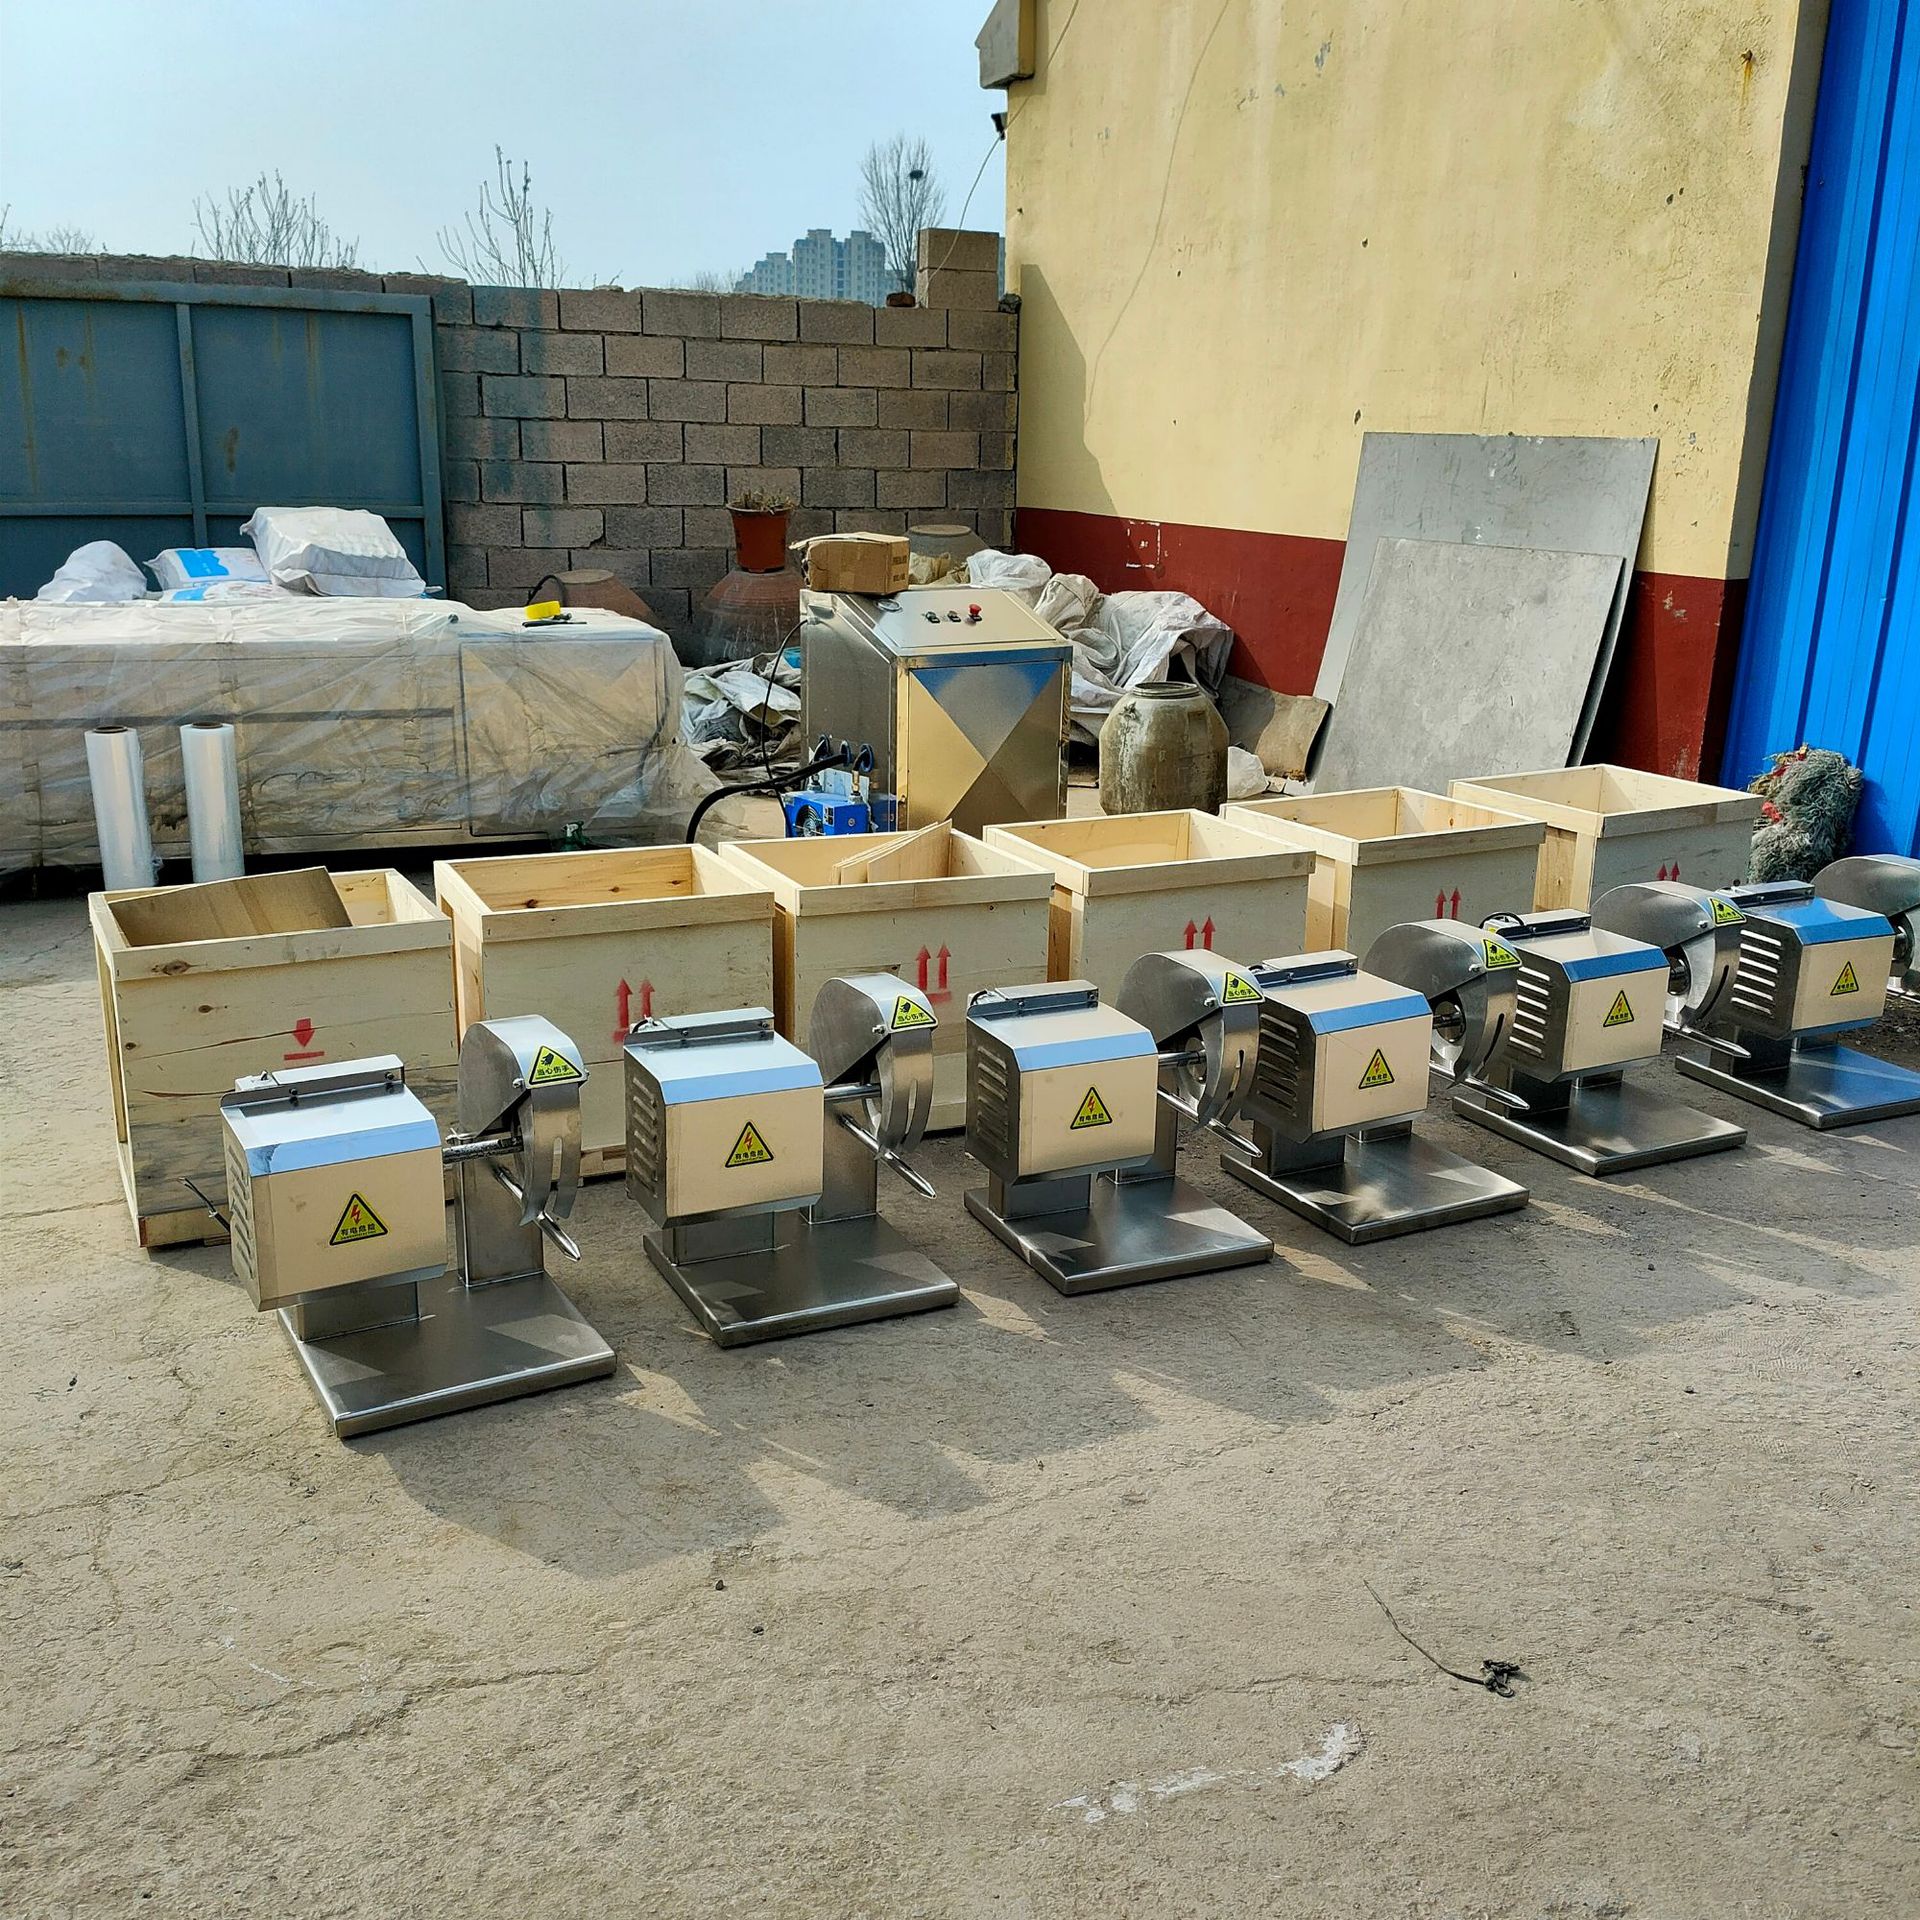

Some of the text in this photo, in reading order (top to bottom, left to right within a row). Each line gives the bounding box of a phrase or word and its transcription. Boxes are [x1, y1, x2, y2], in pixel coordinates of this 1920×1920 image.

[897, 1013, 926, 1022] 当心伤手
[537, 1064, 569, 1076] 当心伤手
[735, 1150, 763, 1159] 有电危险
[341, 1224, 375, 1236] 有电危险
